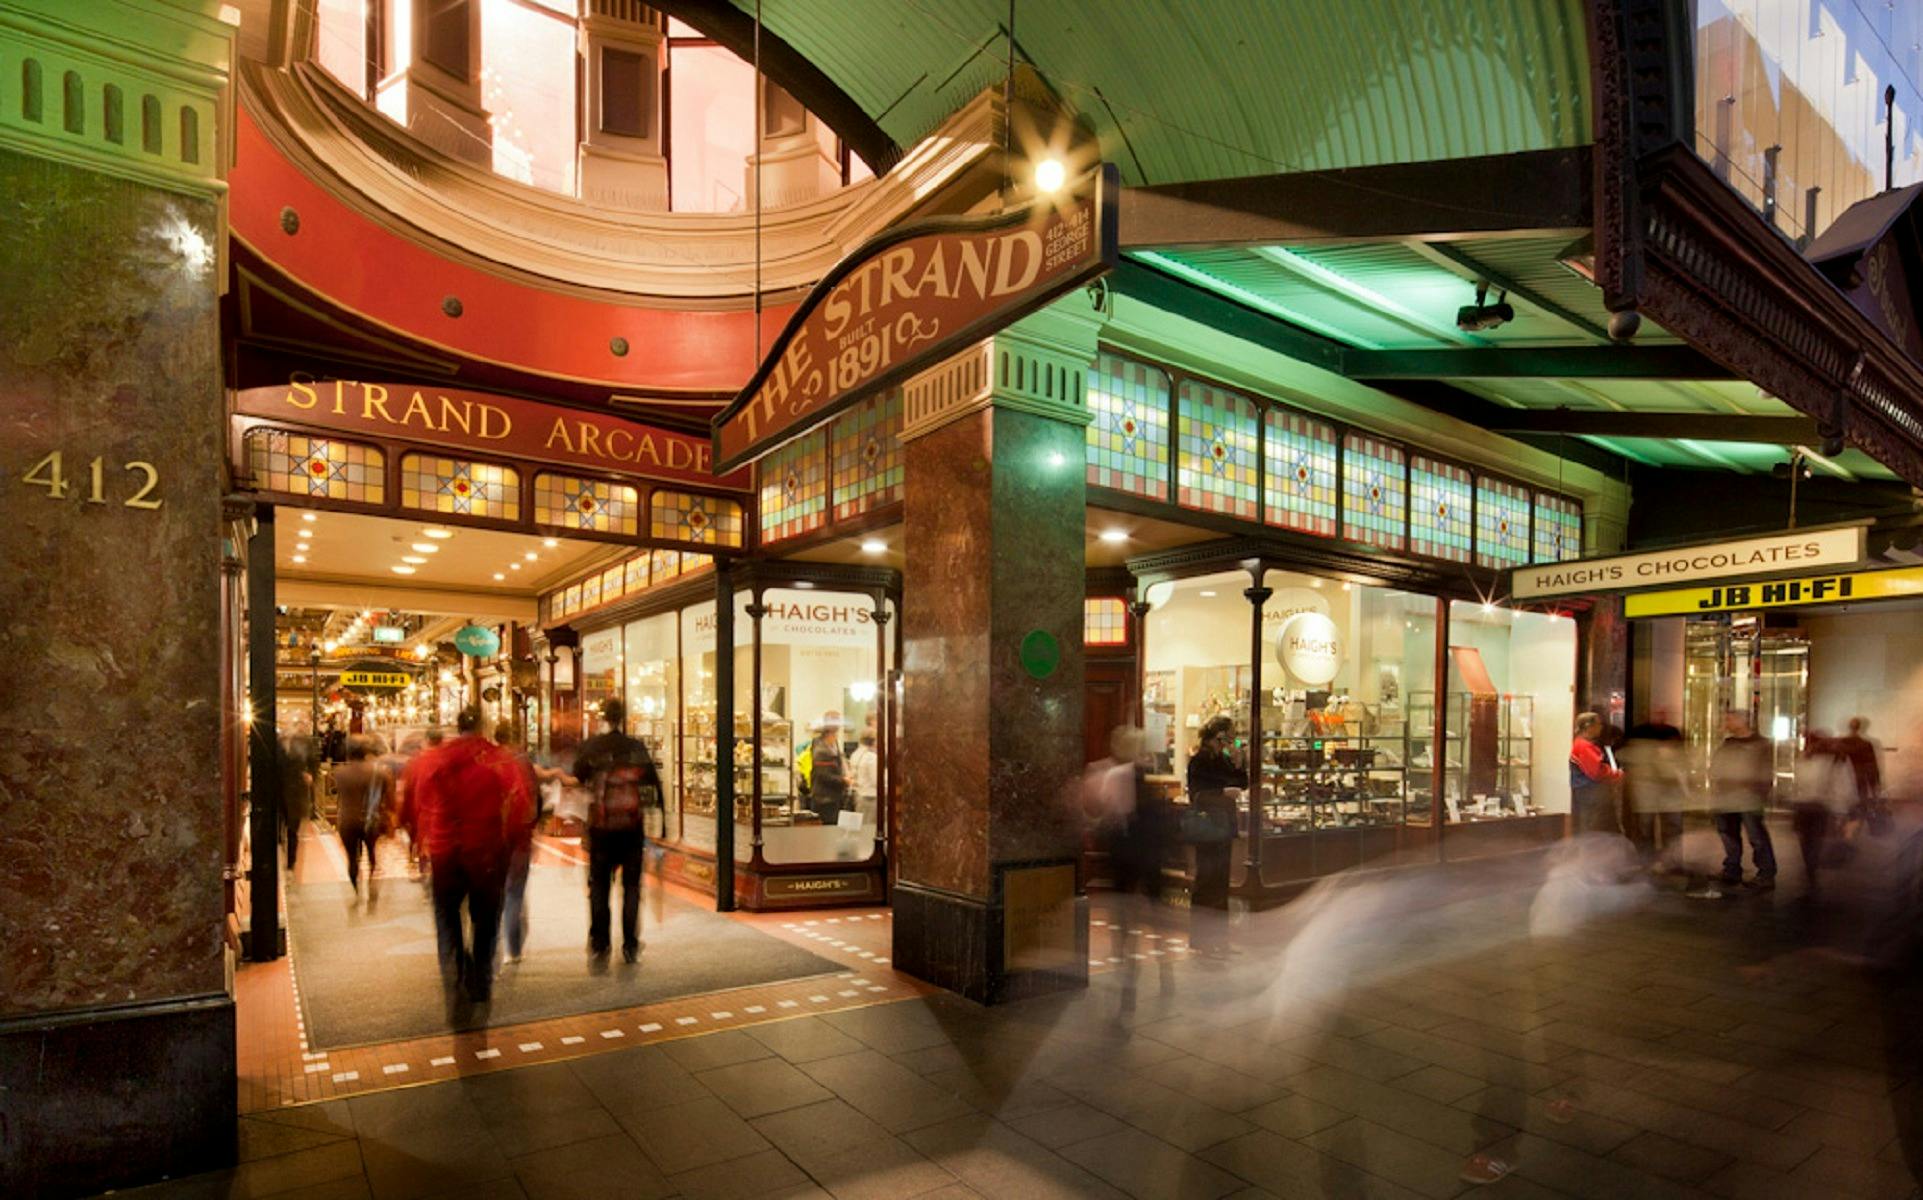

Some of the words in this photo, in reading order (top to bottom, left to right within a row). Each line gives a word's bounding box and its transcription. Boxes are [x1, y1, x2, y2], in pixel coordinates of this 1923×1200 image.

[1046, 222, 1089, 257] GEORGE
[1046, 238, 1087, 272] STREET
[738, 325, 812, 442] THE
[824, 230, 1043, 342] STRAND
[839, 318, 876, 351] BUILT
[828, 322, 892, 398] 1891
[286, 373, 512, 440] STRAND
[545, 416, 713, 474] ARCADE
[22, 451, 163, 510] 412
[1536, 565, 1623, 588] HAIGH'S
[1637, 542, 1821, 577] CHOCOLATES
[1698, 586, 1751, 609] JB
[1761, 577, 1853, 604] HI-FI
[767, 602, 870, 624] HAIGH'S
[784, 625, 857, 636] CHOCOLATES
[347, 674, 368, 684] JB
